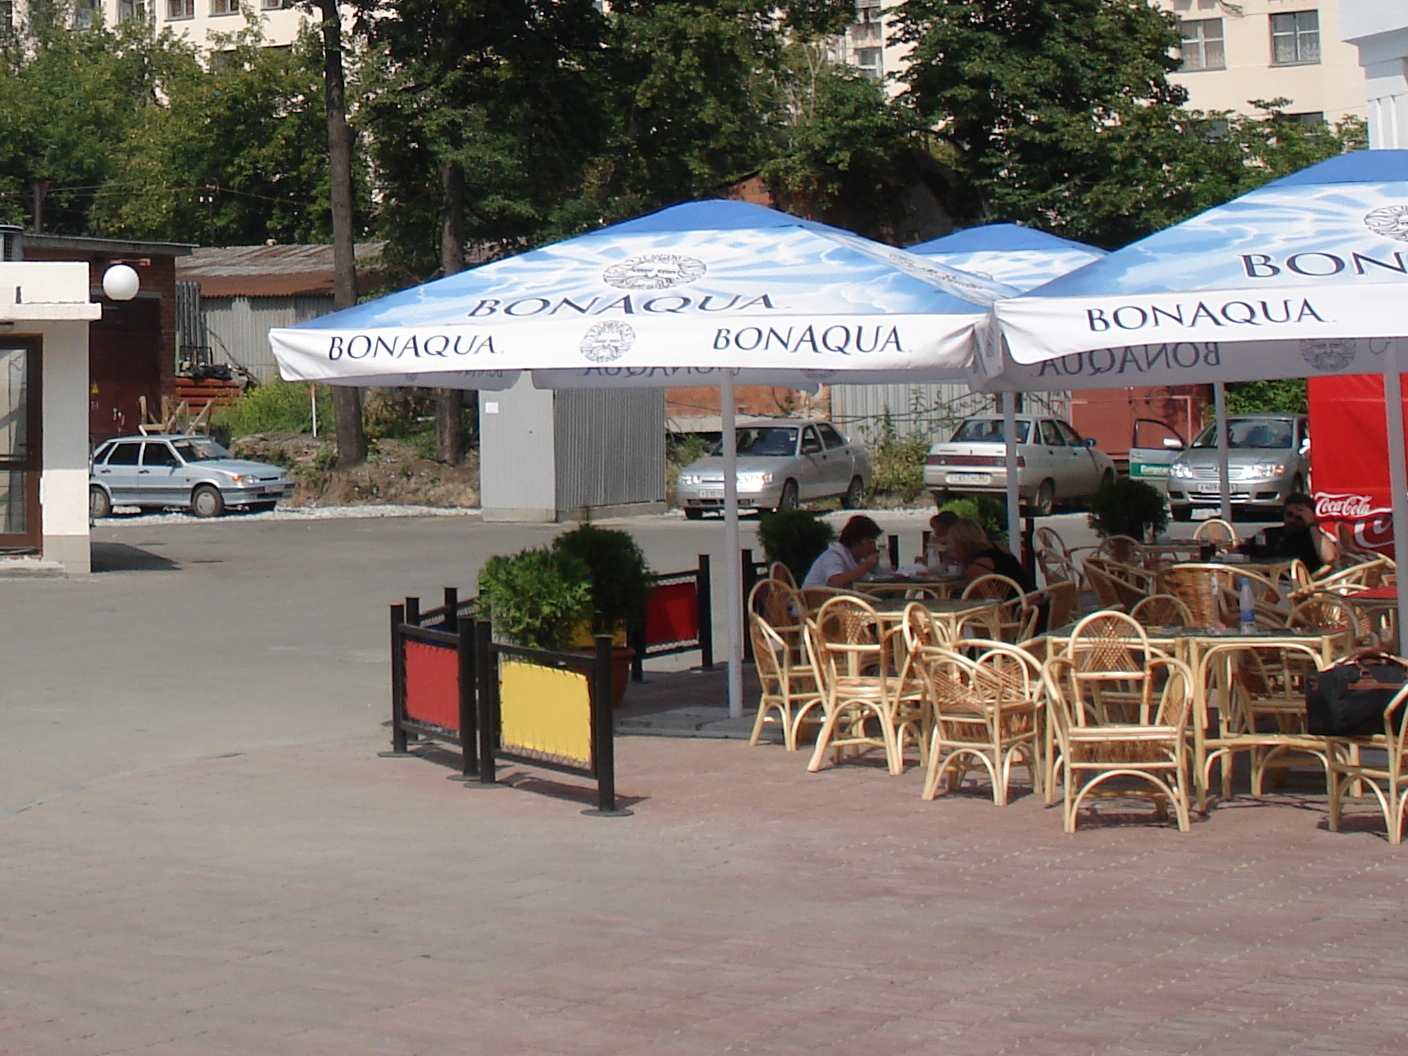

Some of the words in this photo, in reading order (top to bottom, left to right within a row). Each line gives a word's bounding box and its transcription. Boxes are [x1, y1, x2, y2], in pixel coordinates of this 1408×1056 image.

[466, 293, 775, 317] BONAQUA
[1085, 297, 1326, 332] BONAQUA
[328, 334, 497, 360] BONAQUA
[712, 324, 904, 356] BONAQUA
